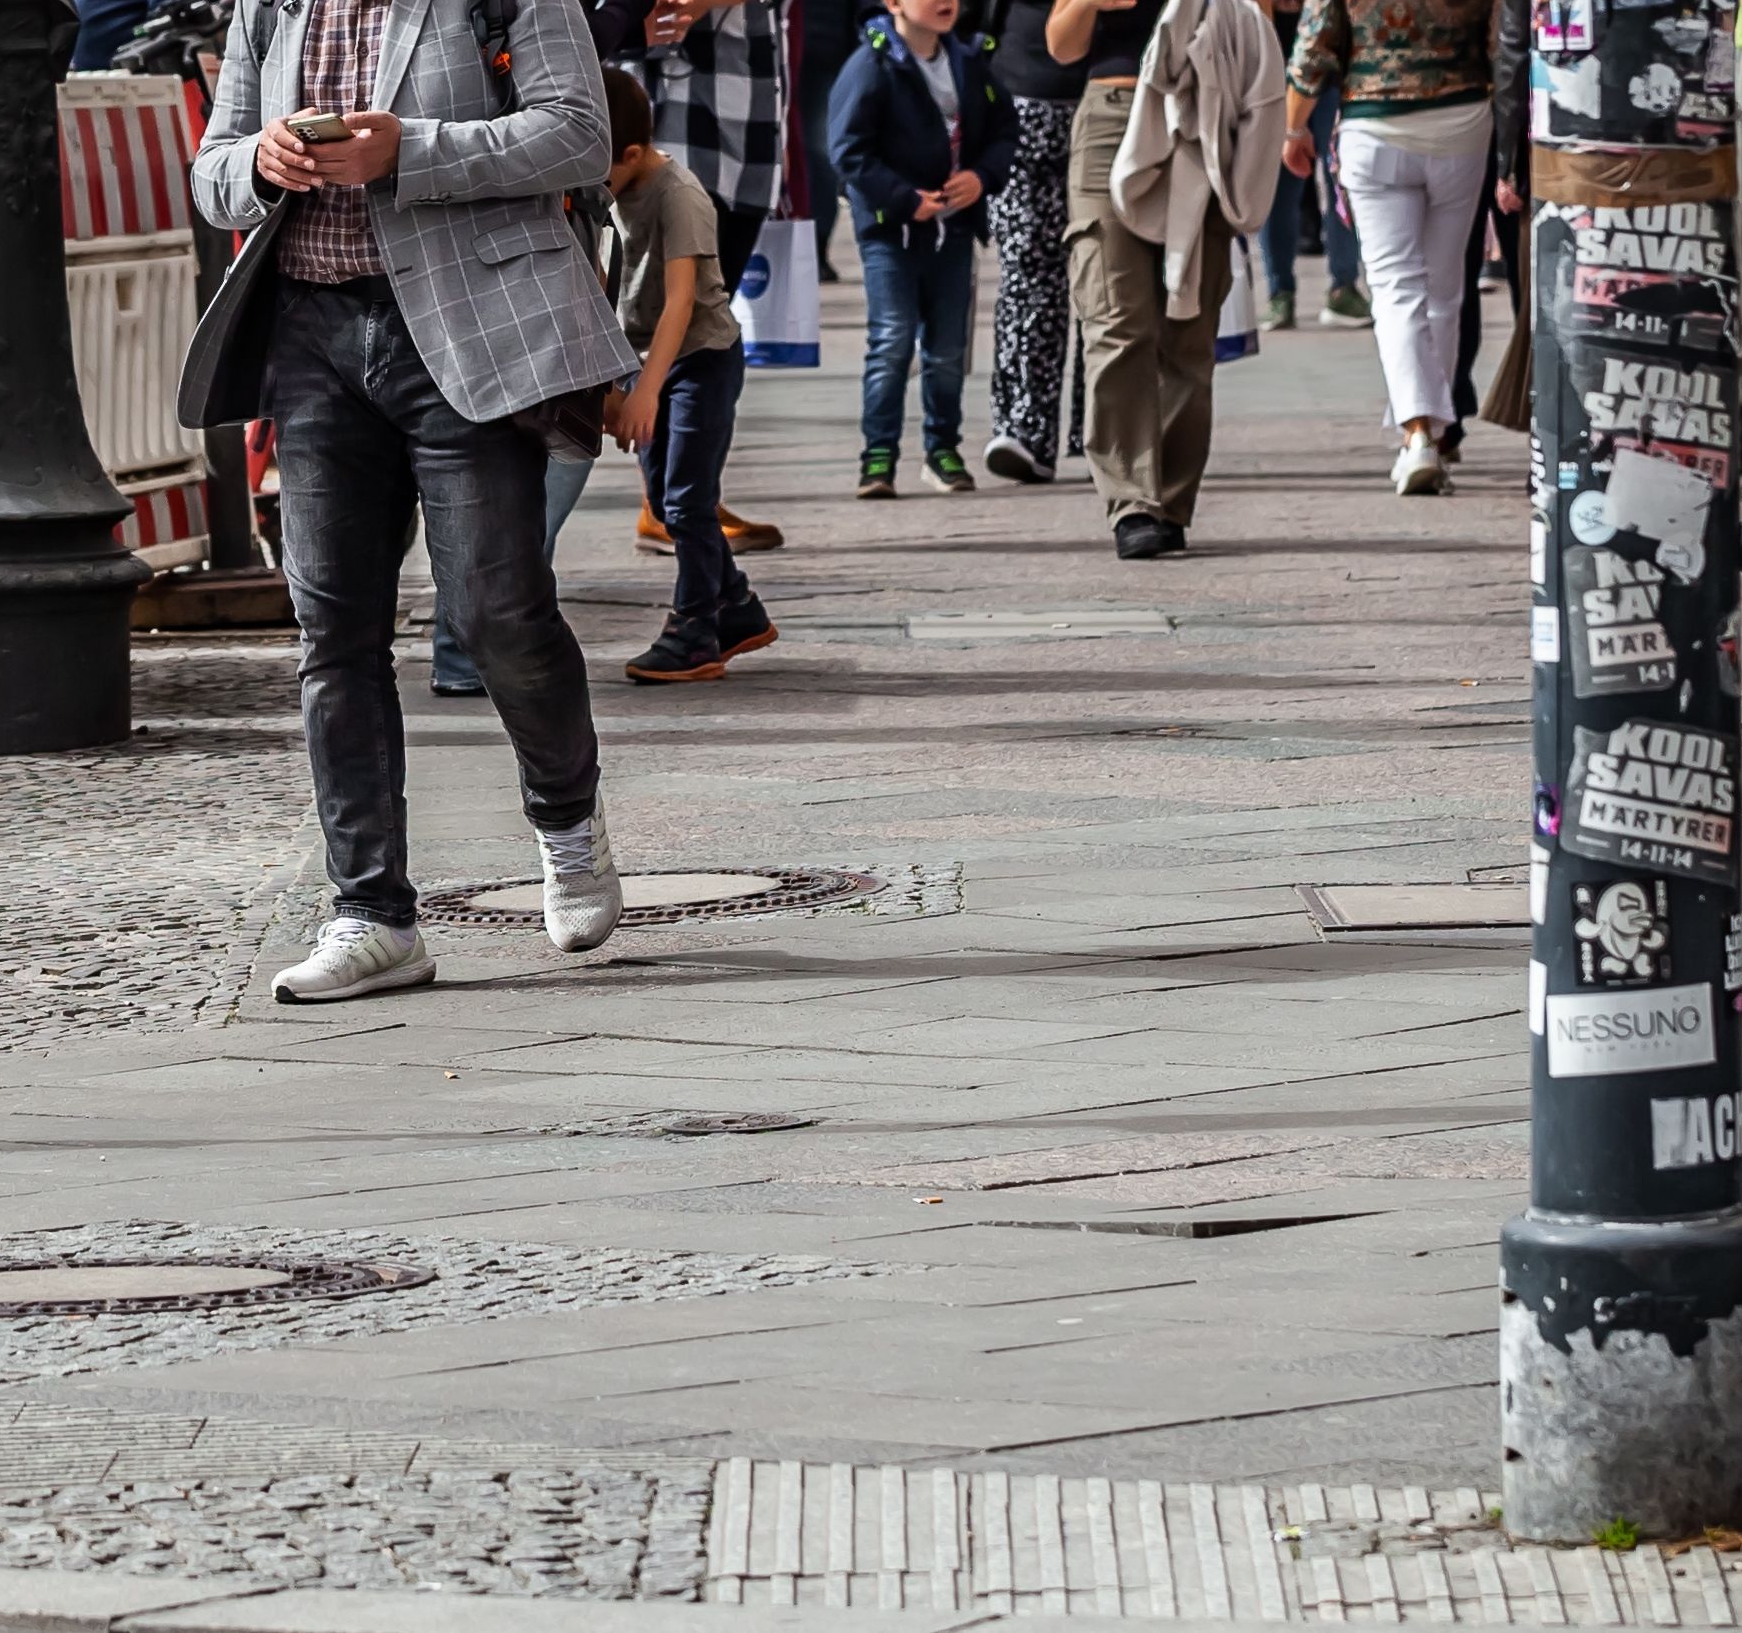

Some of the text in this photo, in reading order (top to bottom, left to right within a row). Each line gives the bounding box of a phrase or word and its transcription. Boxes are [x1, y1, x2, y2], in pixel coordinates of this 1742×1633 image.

[1575, 228, 1726, 275] SAVAS
[1607, 722, 1731, 776] KOOL
[1586, 752, 1735, 814] SAVAS
[1557, 1005, 1701, 1043] NESSUNO
